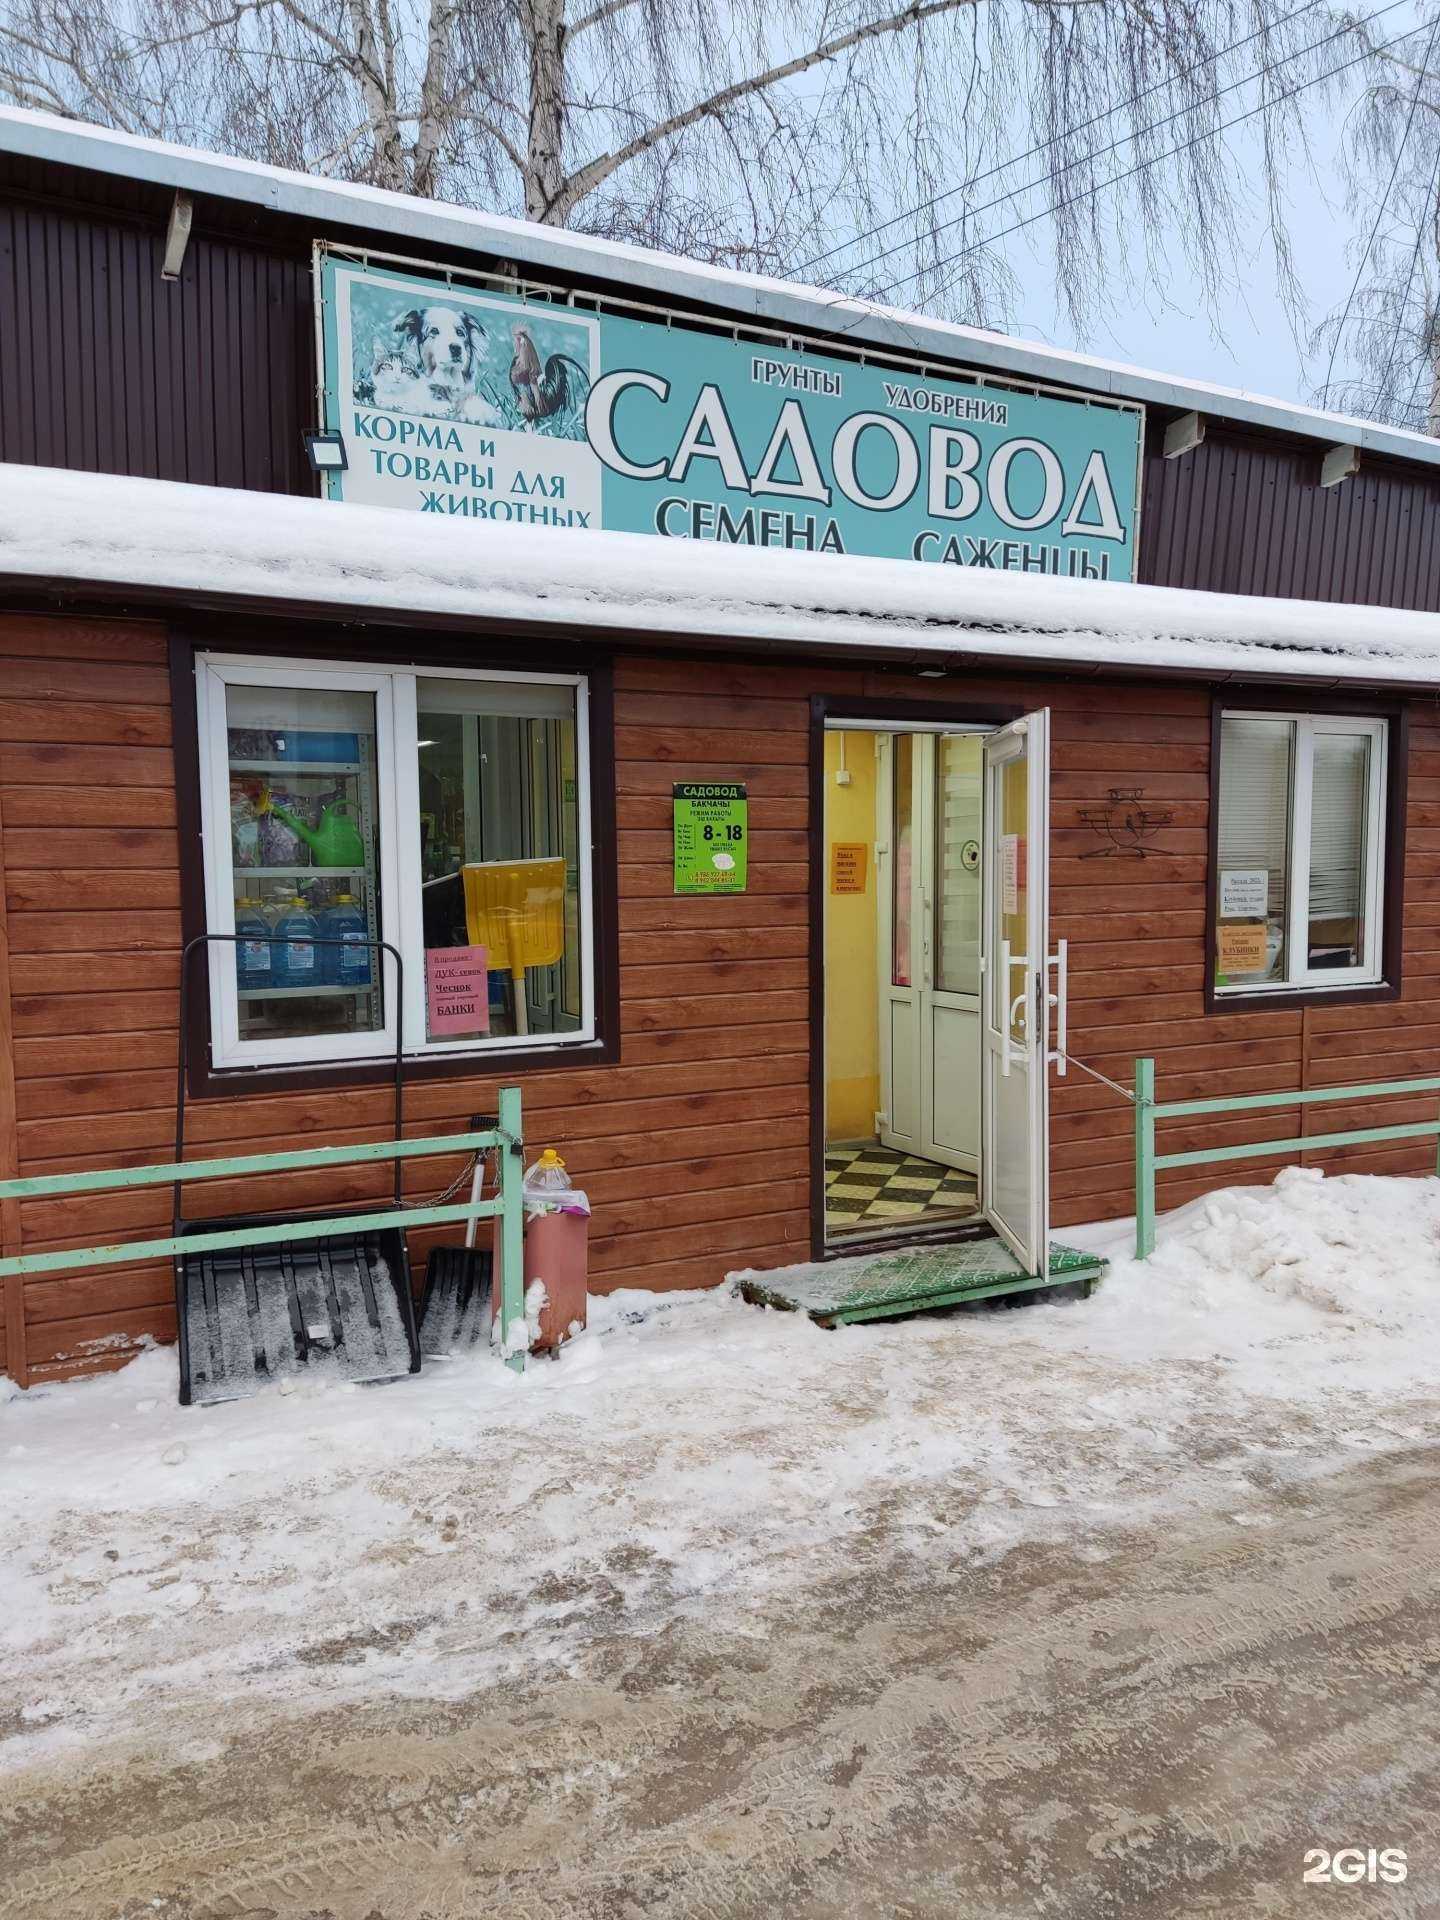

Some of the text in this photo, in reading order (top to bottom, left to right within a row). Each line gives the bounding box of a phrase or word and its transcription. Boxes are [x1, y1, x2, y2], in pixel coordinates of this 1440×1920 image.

[752, 357, 1009, 427] ГРУНТЫ УДОБРЕНИЯ
[354, 412, 463, 453] КОРМА
[370, 449, 565, 499] ТОВАРЫ ДЛЯ
[585, 369, 1127, 545] САДОВОД
[420, 490, 592, 528] ЖИВОТНЫХ
[655, 496, 845, 555] СЕМЕНА
[683, 786, 738, 798] САДОВОД
[435, 984, 472, 993] Чеснок
[437, 1003, 475, 1017] БАНКИ
